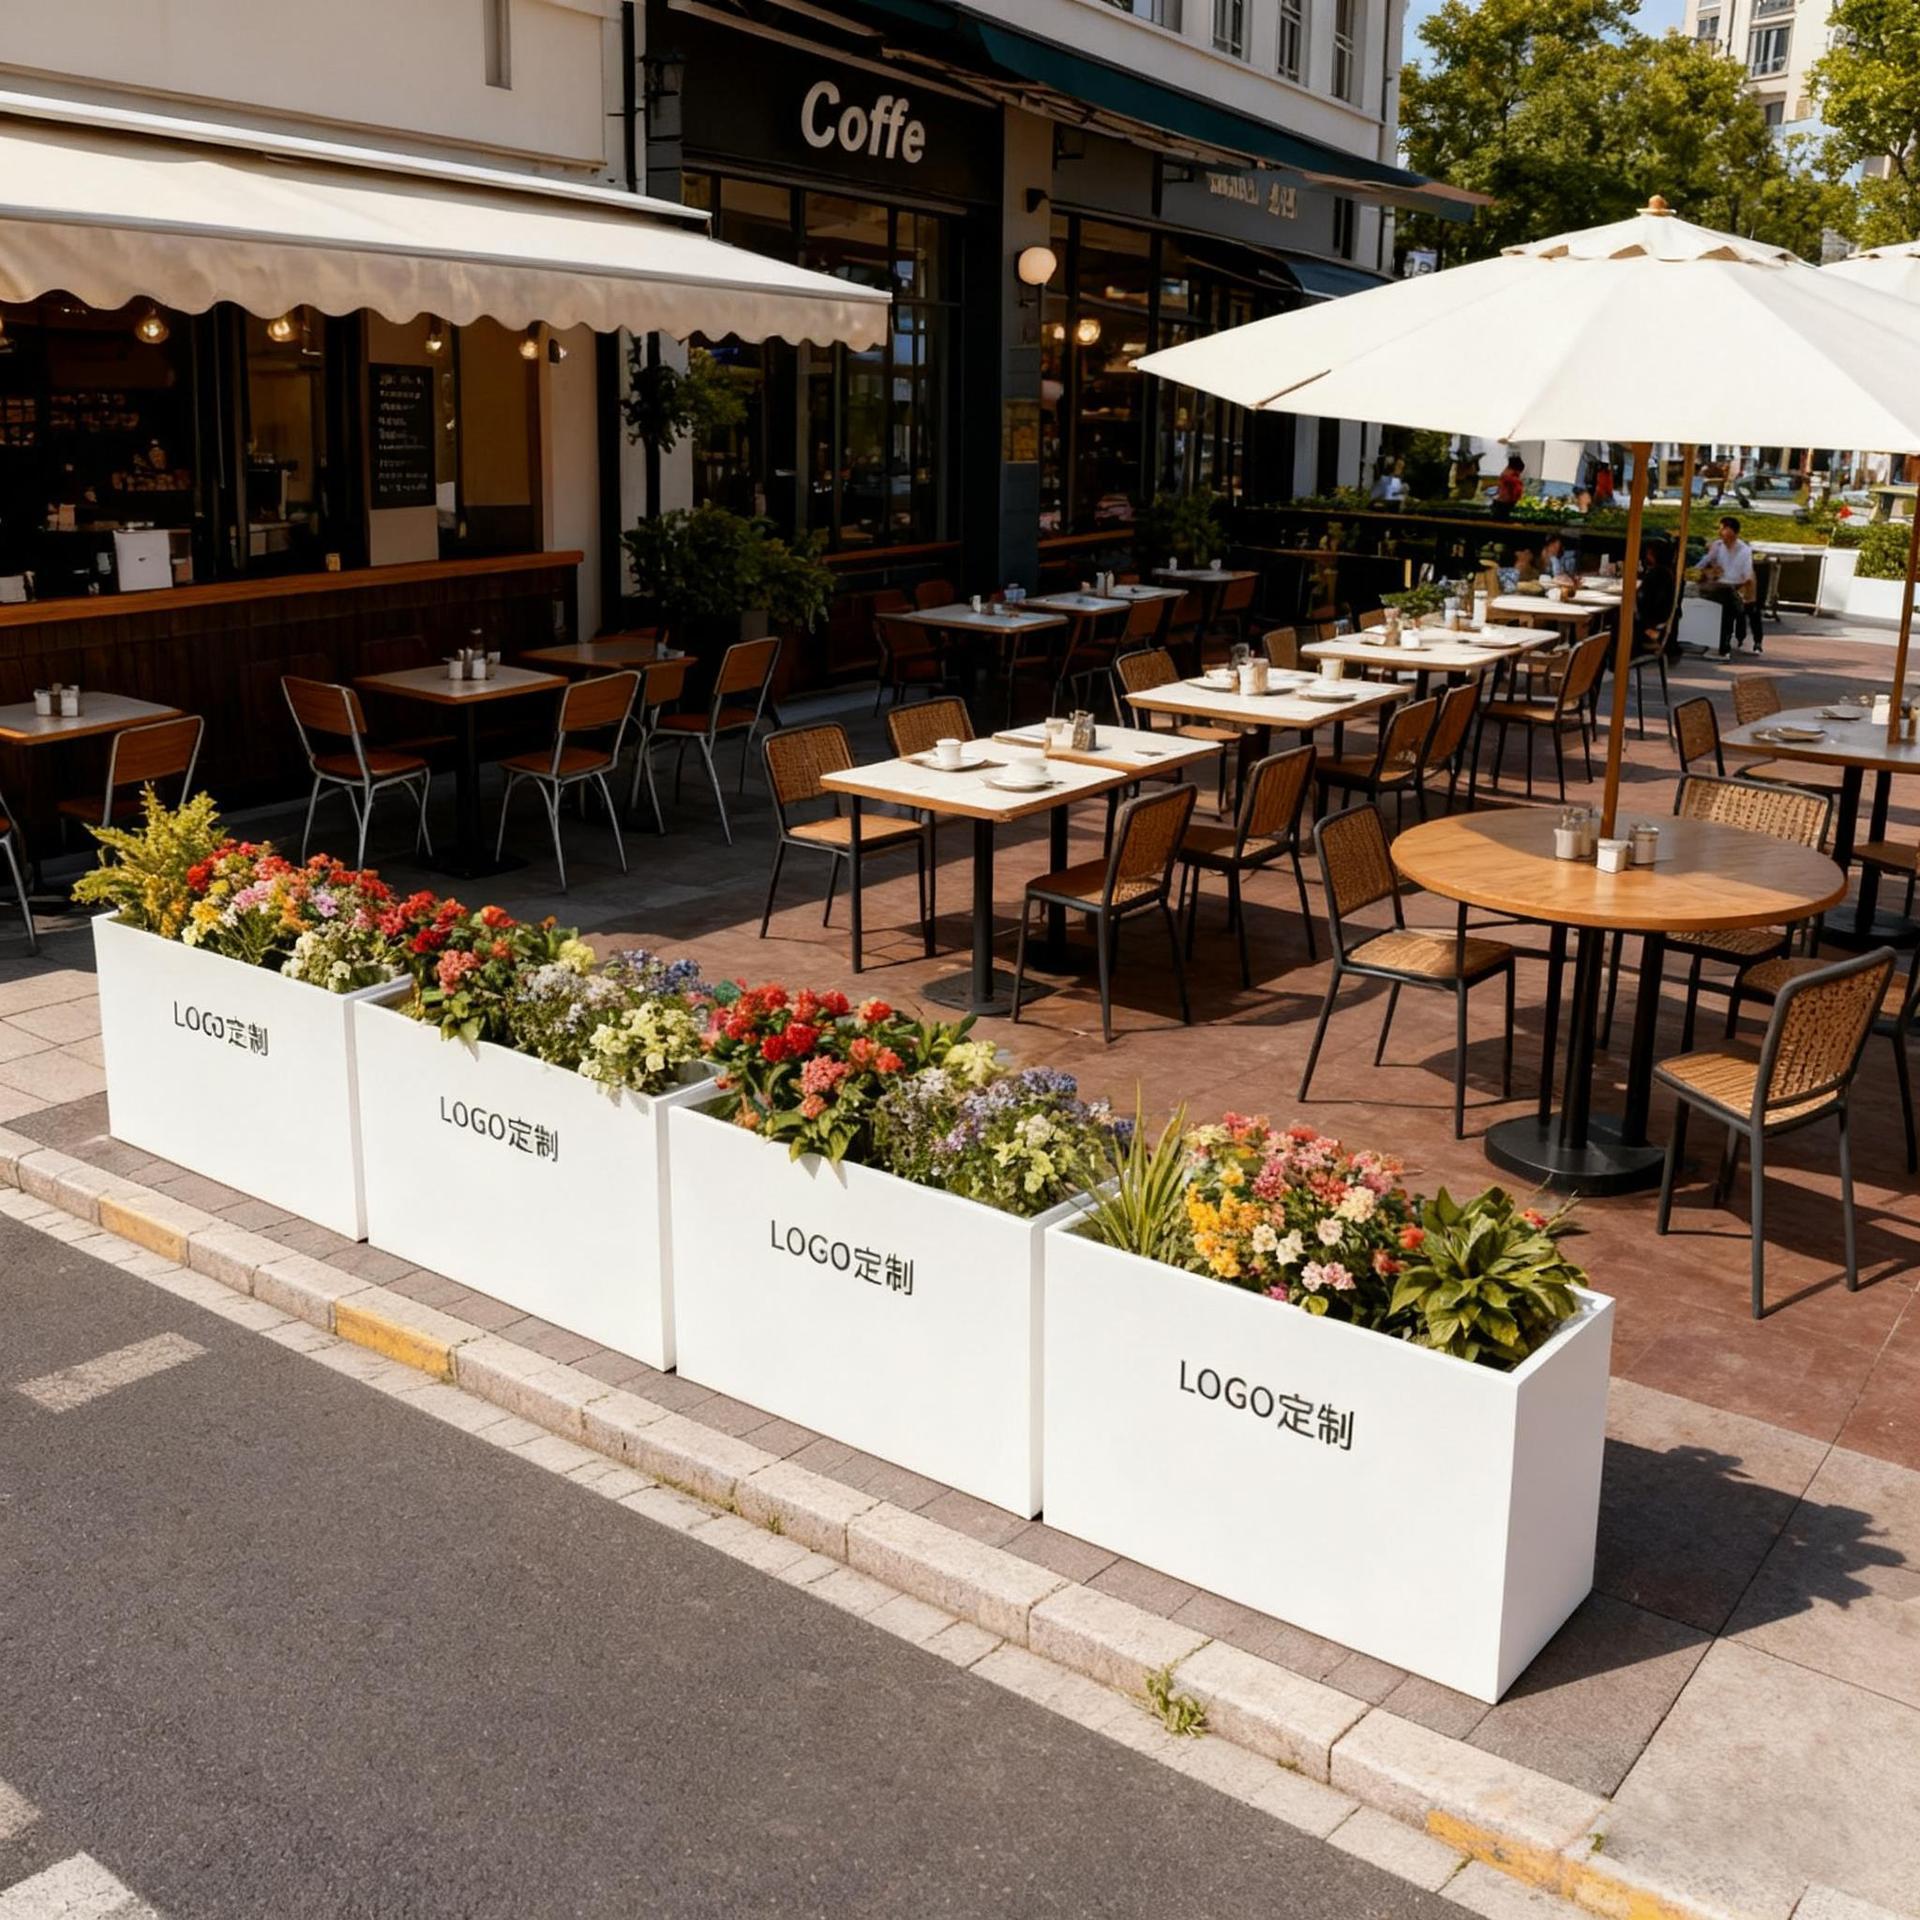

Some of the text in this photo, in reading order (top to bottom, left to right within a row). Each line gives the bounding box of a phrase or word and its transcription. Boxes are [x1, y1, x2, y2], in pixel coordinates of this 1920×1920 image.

[801, 81, 925, 163] Coffe
[440, 1096, 558, 1162] LOGO定制
[771, 1220, 914, 1296] LOGO定制
[1180, 1360, 1355, 1451] LOGO定制
